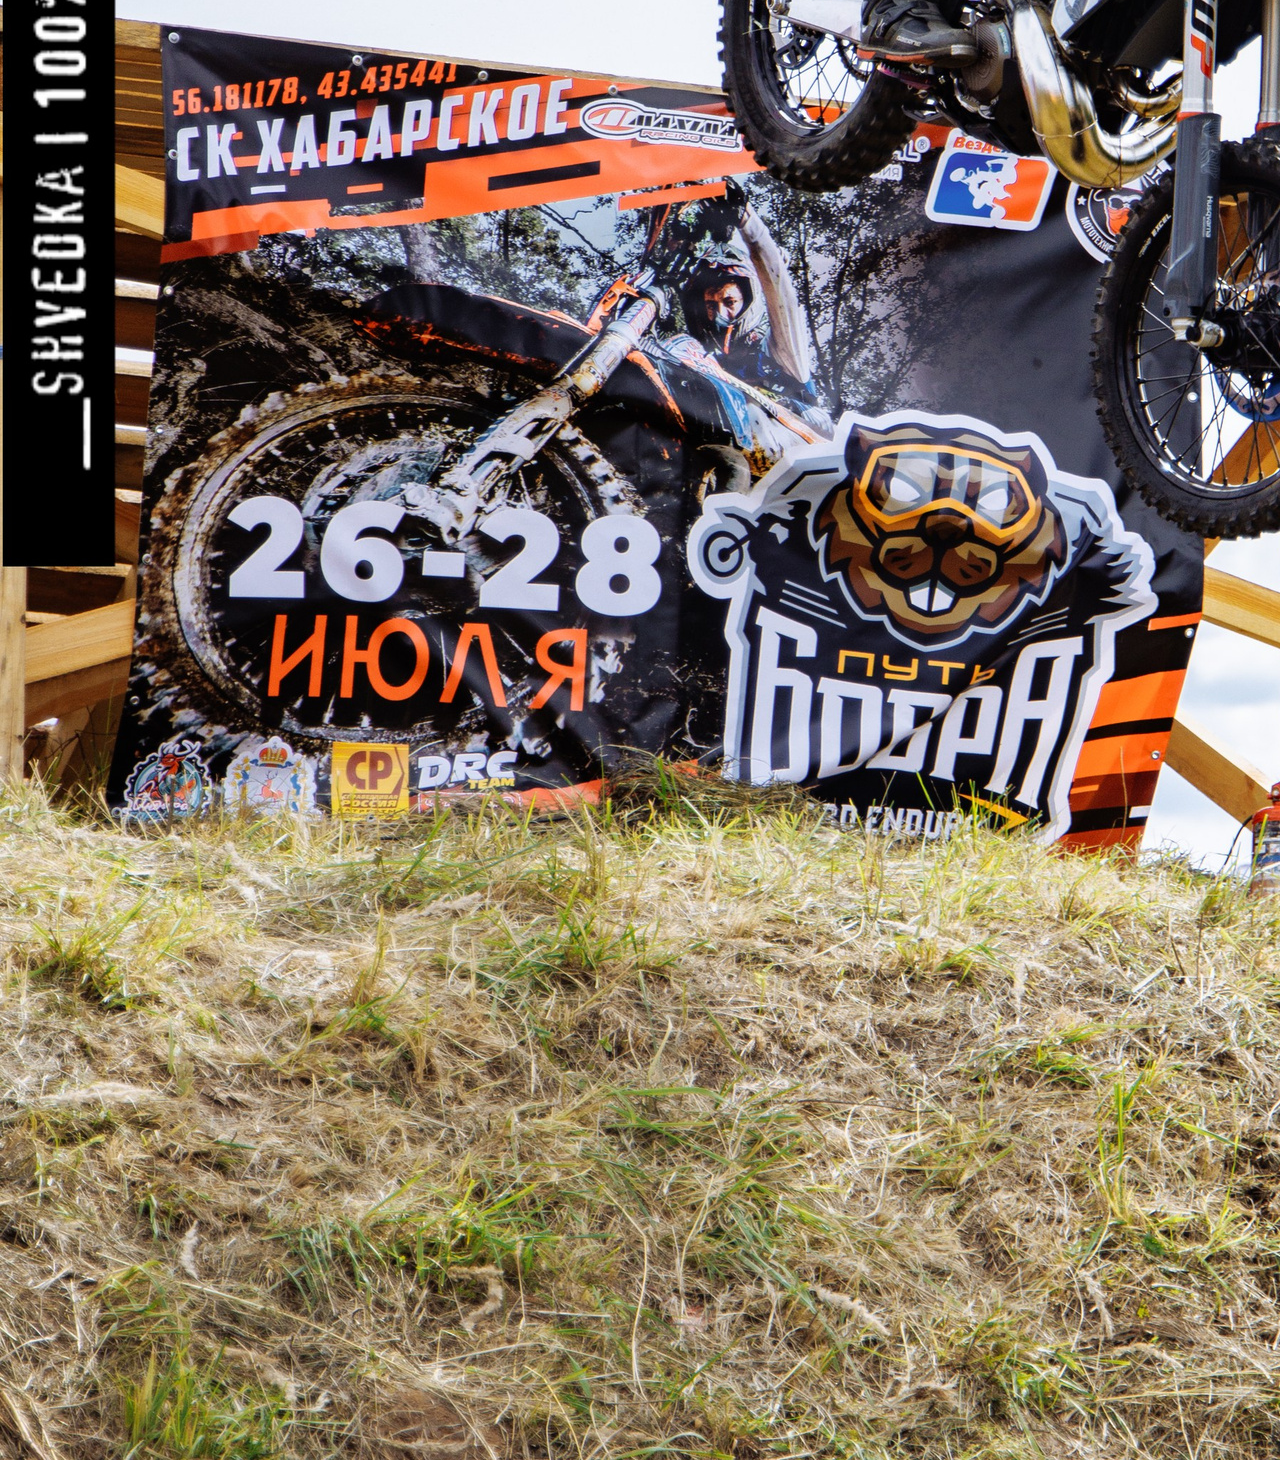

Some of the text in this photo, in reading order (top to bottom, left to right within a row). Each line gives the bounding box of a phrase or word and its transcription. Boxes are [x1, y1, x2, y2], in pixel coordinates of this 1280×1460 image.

[172, 61, 458, 117] 56.181178, 43.435441
[176, 78, 575, 182] СК ХАБАРСКОЕ
[627, 114, 737, 137] MAXIMA
[641, 129, 735, 146] RACING OILS
[1151, 213, 1172, 238] EXCEL
[1205, 195, 1214, 239] Husqvarna
[227, 495, 663, 617] 26-28
[267, 613, 588, 712] ИЮЛЯ
[837, 648, 997, 685] ПУТЬ
[749, 607, 1084, 811] БОБРА
[418, 750, 519, 789] DRC
[467, 777, 516, 790] TEAM
[341, 800, 398, 808] РОССИЯ
